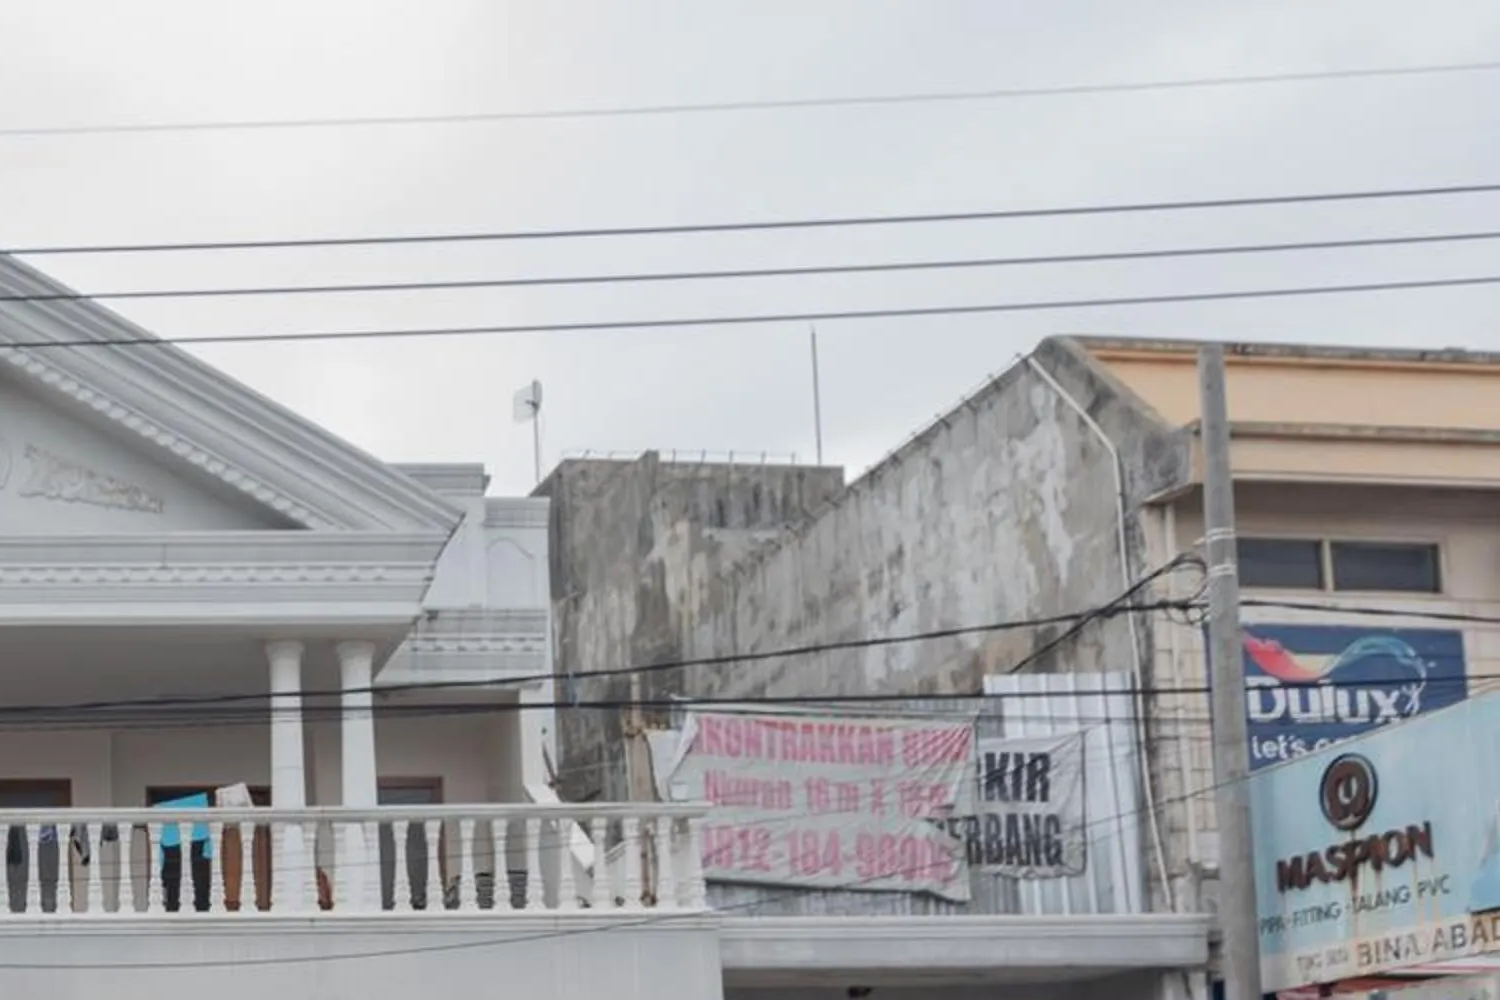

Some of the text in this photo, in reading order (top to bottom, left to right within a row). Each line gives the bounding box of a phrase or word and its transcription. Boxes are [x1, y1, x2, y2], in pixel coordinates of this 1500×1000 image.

[1246, 676, 1400, 723] Dulux
[976, 752, 1050, 801] KIR
[1276, 820, 1434, 893] MASPION
[1417, 874, 1453, 900] PVC
[1356, 936, 1421, 967] BINA
